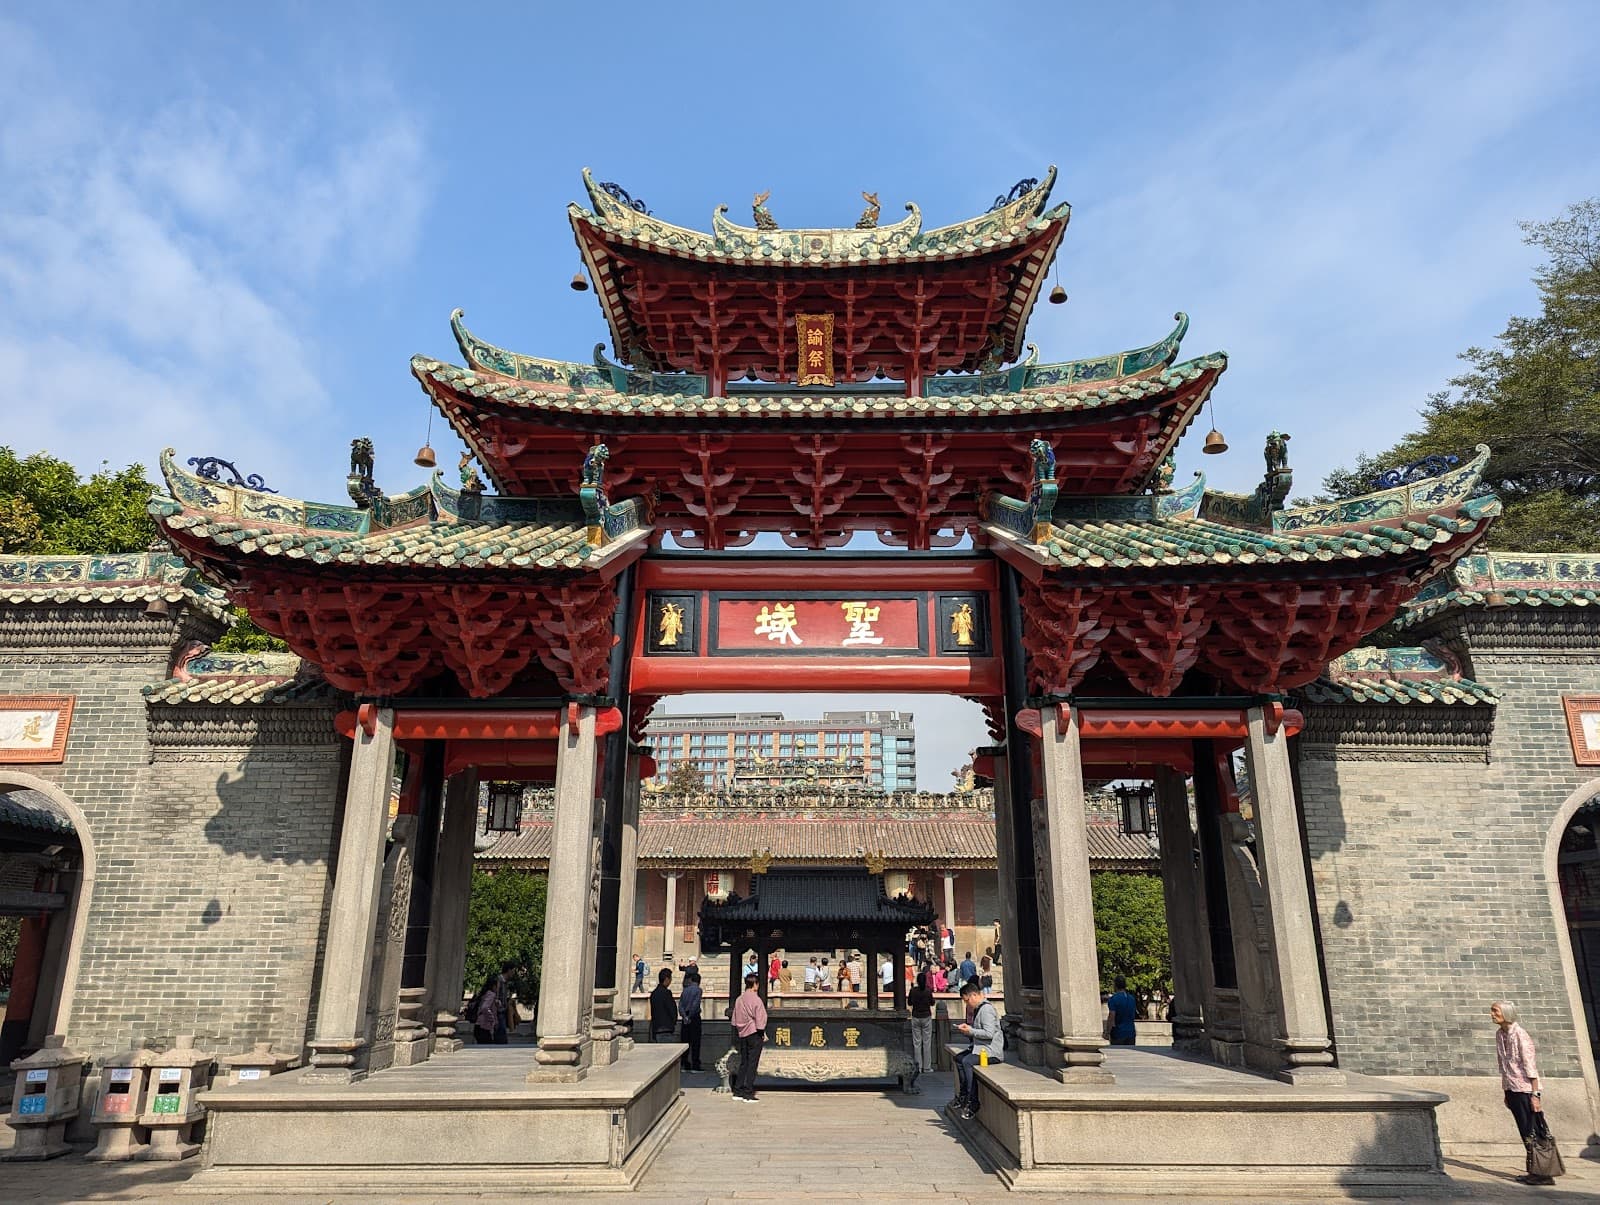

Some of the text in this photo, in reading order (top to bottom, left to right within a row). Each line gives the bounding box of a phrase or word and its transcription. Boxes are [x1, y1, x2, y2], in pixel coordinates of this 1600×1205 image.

[806, 328, 825, 368] 諭祭
[754, 601, 884, 646] 聖域
[775, 1026, 861, 1047] 靈應祠
